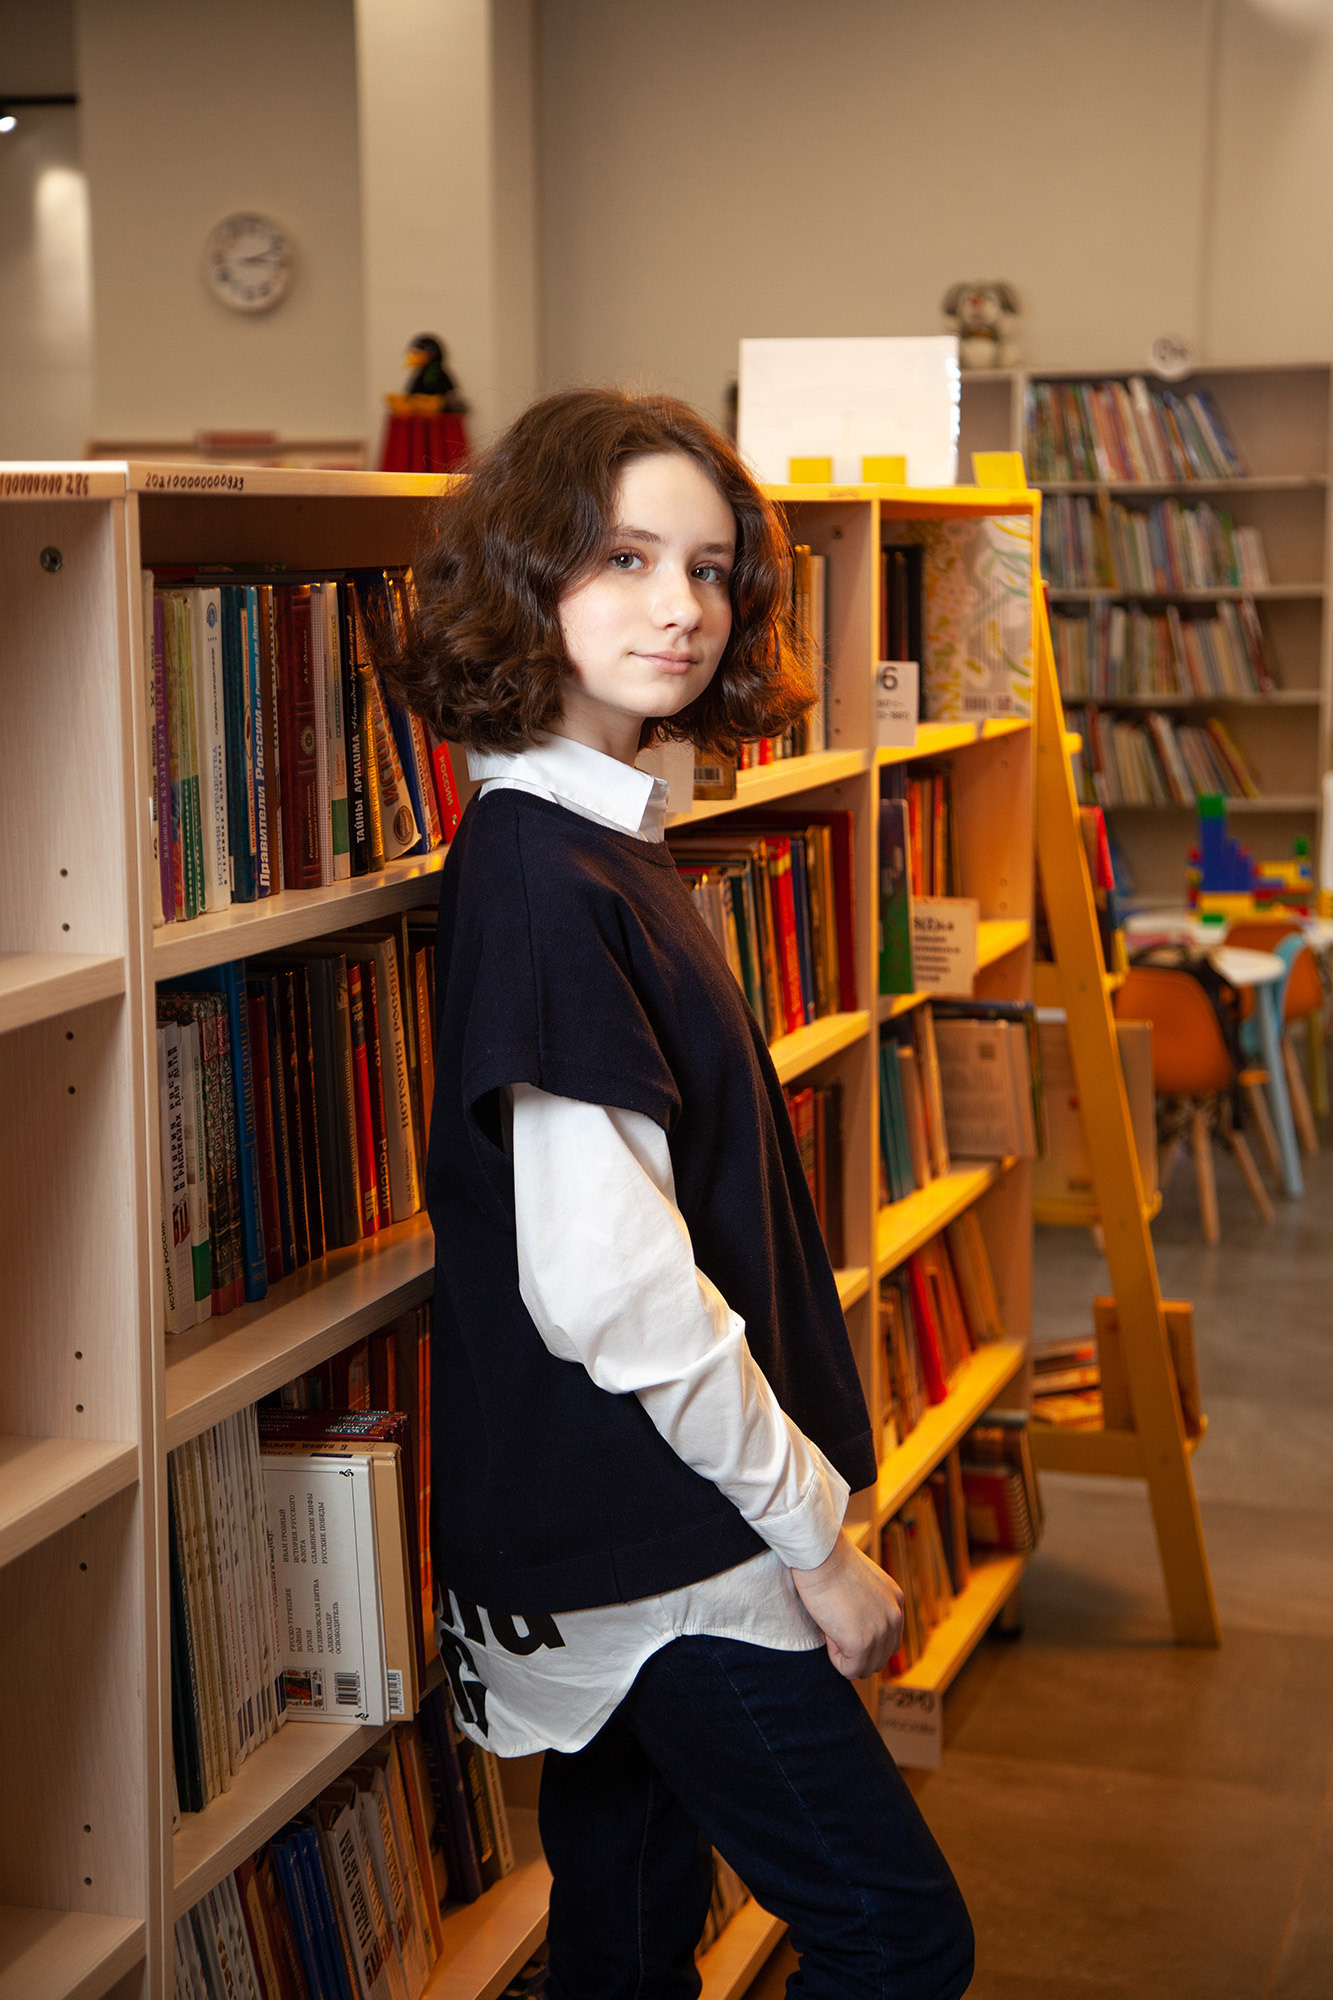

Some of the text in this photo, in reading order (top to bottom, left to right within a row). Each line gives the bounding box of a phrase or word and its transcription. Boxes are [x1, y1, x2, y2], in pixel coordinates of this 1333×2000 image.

[251, 604, 259, 640] Путина
[253, 656, 261, 696] Рюрика
[255, 708, 267, 781] России
[352, 733, 363, 793] АРКАИМА
[439, 754, 454, 807] РОССИИ
[212, 745, 224, 887] ИСТОРИЯ ОТЕЧЕСТВА
[258, 786, 271, 887] Правители
[355, 799, 366, 844] ТАЙНЫ
[172, 1045, 180, 1078] ДЕТЕЙ
[389, 954, 410, 1130] ИСТОРИЯ РОССИИ
[168, 1047, 180, 1193] ИСТОРИЯ РОССИИ
[174, 1085, 184, 1107] ДЛЯ
[176, 1112, 185, 1176] РАССКАЗАХ
[380, 1136, 391, 1210] РОССИИ
[166, 1266, 176, 1311] ИСТОРИЯ
[278, 1509, 290, 1563] ИВАН ГРОЗНЫЙ
[288, 1495, 300, 1563] ИСТОРИЯ РУССКОГО
[299, 1539, 307, 1563] ФЛОТА
[306, 1492, 318, 1564] СЛАВЯНСКИЕ МИФЫ
[317, 1502, 328, 1564] РУССКИЕ ПОБЕДЫ
[285, 1587, 296, 1653] РУССКО-ТУРЕЦКИЕ
[295, 1627, 304, 1653] ВОЙНЫ
[306, 1629, 315, 1654] ДУЭЛИ
[312, 1579, 325, 1654] КУЛИКОВСКАЯ БИТВА
[325, 1612, 335, 1655] АЛЕКСАНДР
[332, 1601, 342, 1655] ОСВОБОДИТЕЛЬ
